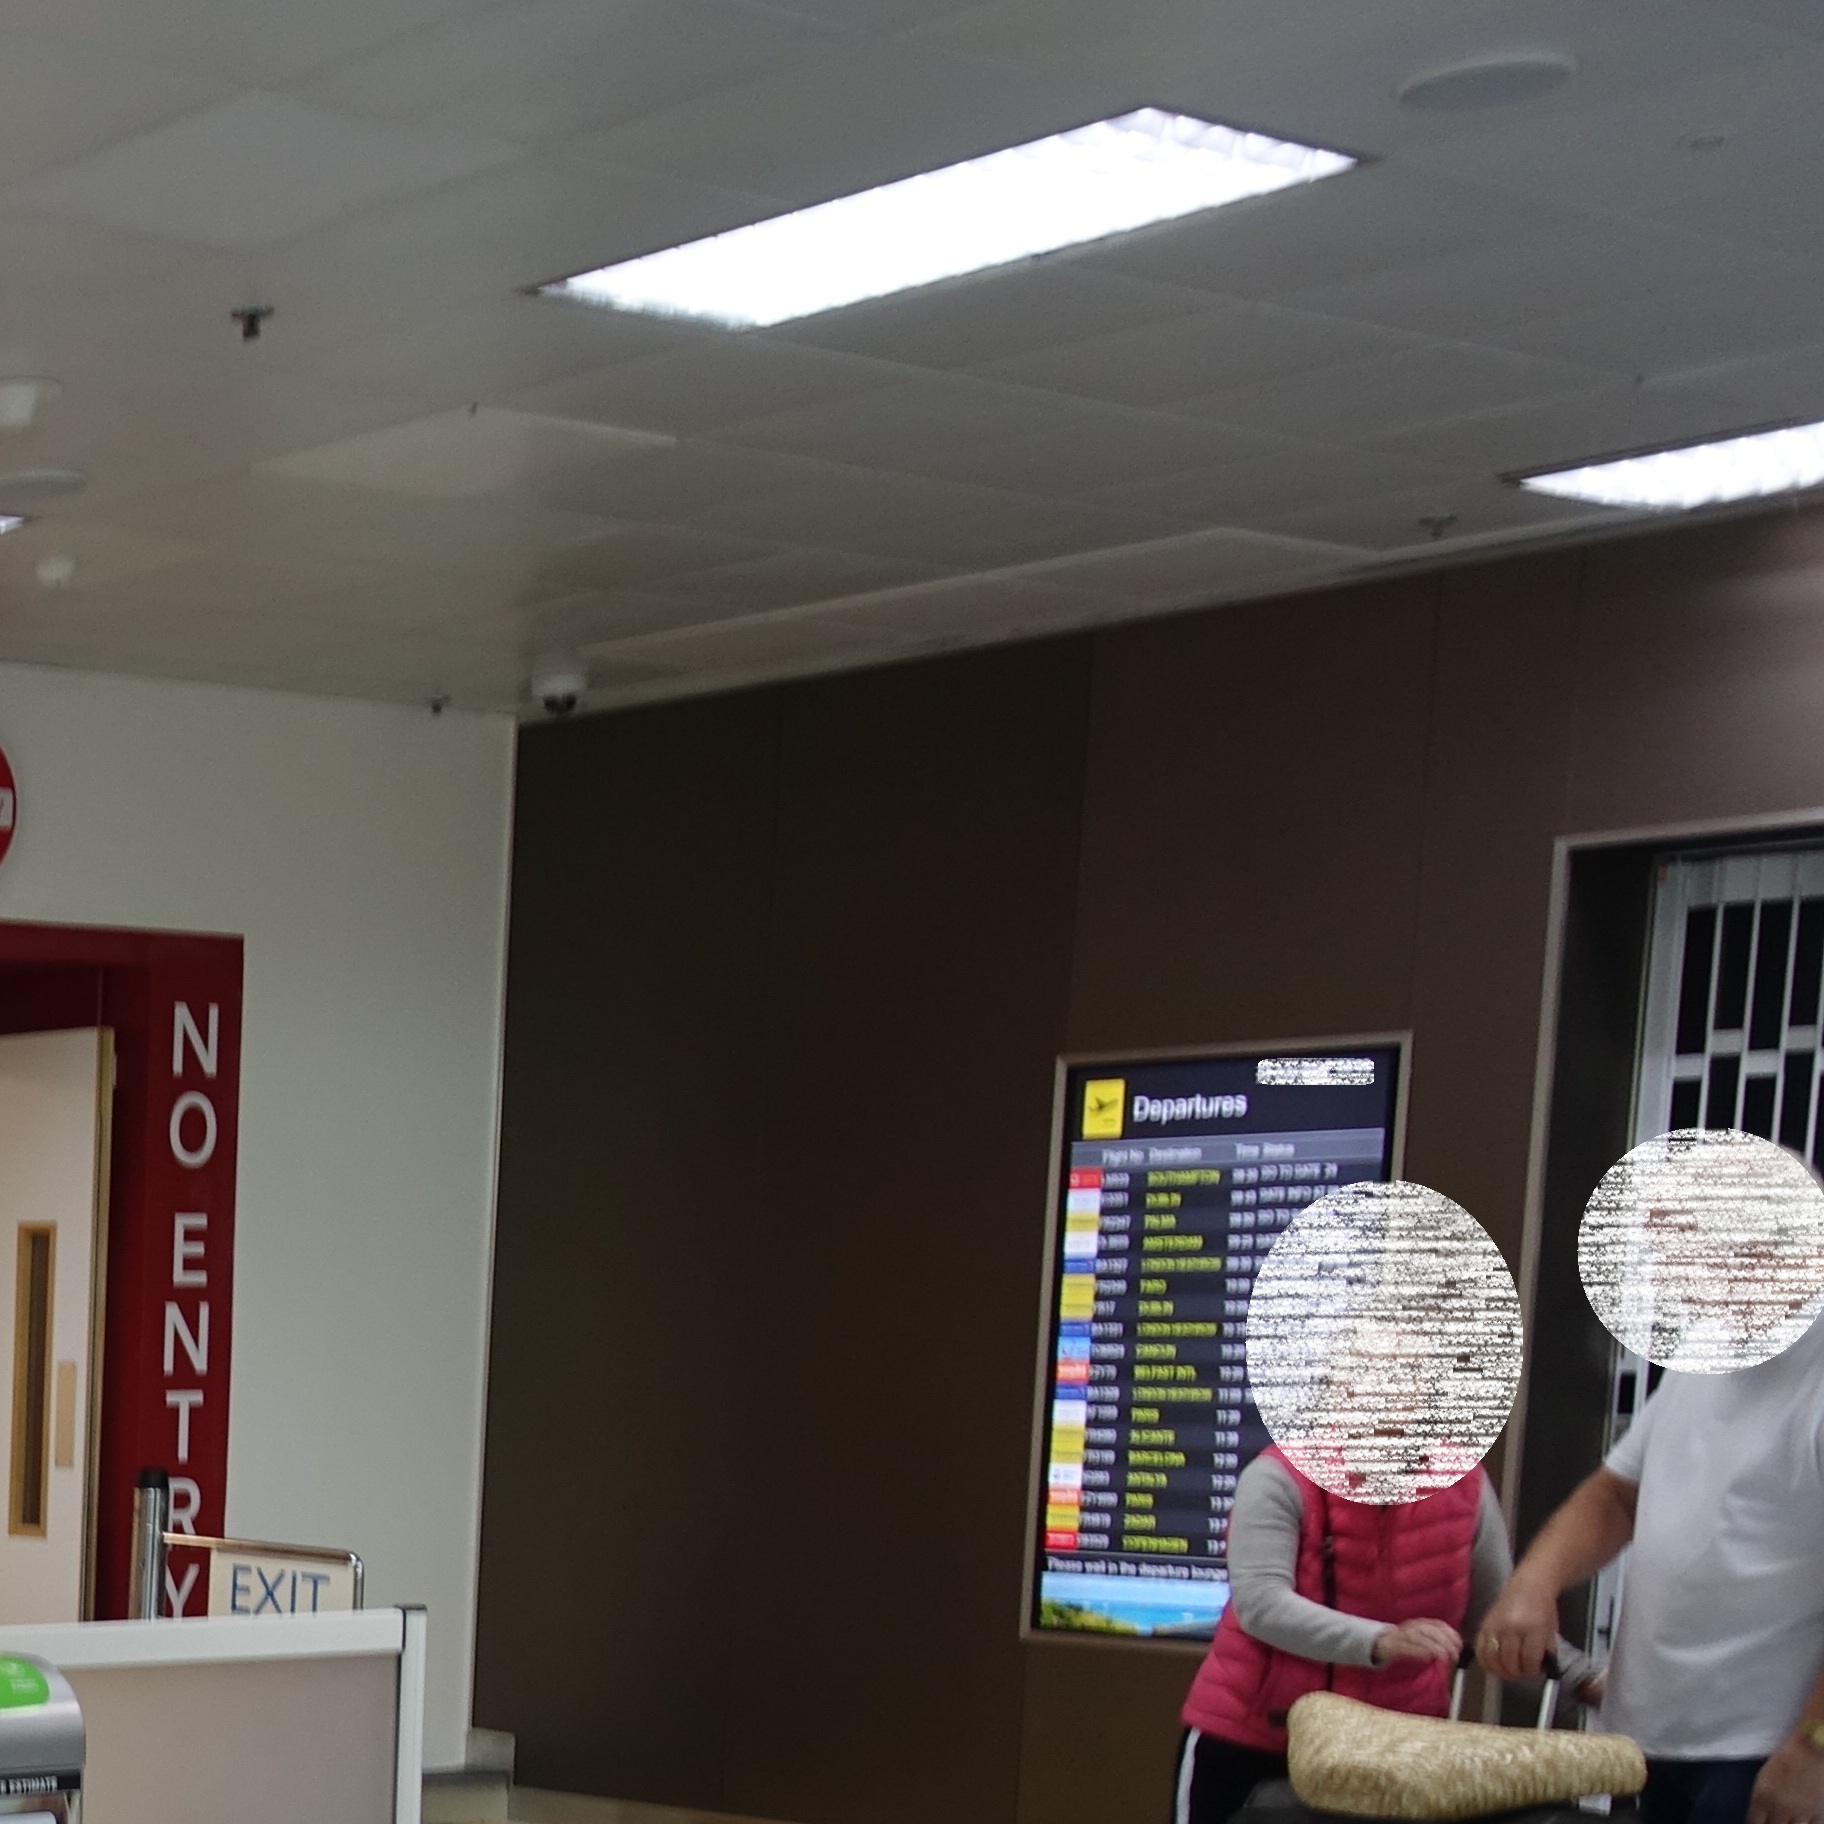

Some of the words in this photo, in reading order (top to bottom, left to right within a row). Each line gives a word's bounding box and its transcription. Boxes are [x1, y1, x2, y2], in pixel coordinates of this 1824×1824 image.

[170, 1001, 218, 1169] NO
[1132, 1092, 1248, 1125] Departures
[164, 1211, 210, 1617] ENTRY
[231, 1562, 330, 1615] EXIT
